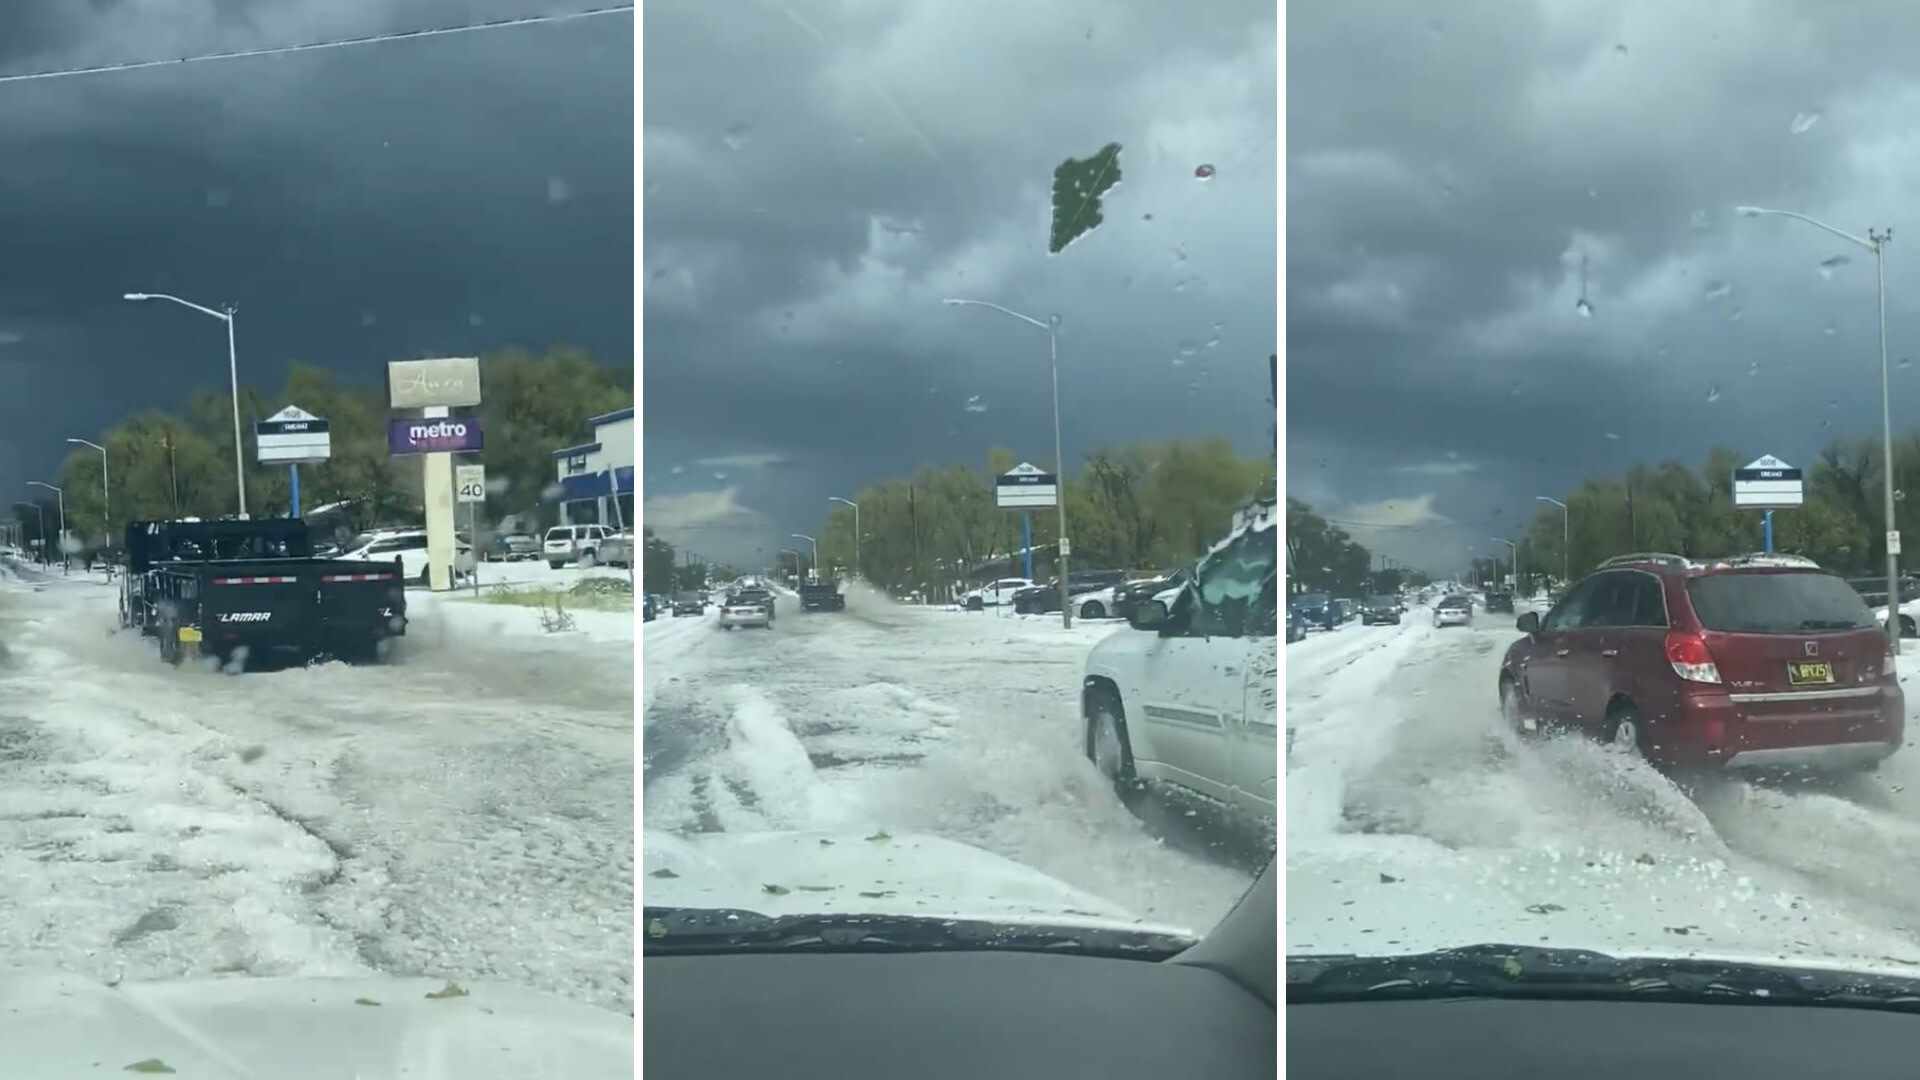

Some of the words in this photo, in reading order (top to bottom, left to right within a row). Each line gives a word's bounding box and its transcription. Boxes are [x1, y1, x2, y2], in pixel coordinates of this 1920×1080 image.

[410, 422, 467, 438] metro
[460, 484, 482, 497] 40
[222, 612, 271, 622] LAMAR
